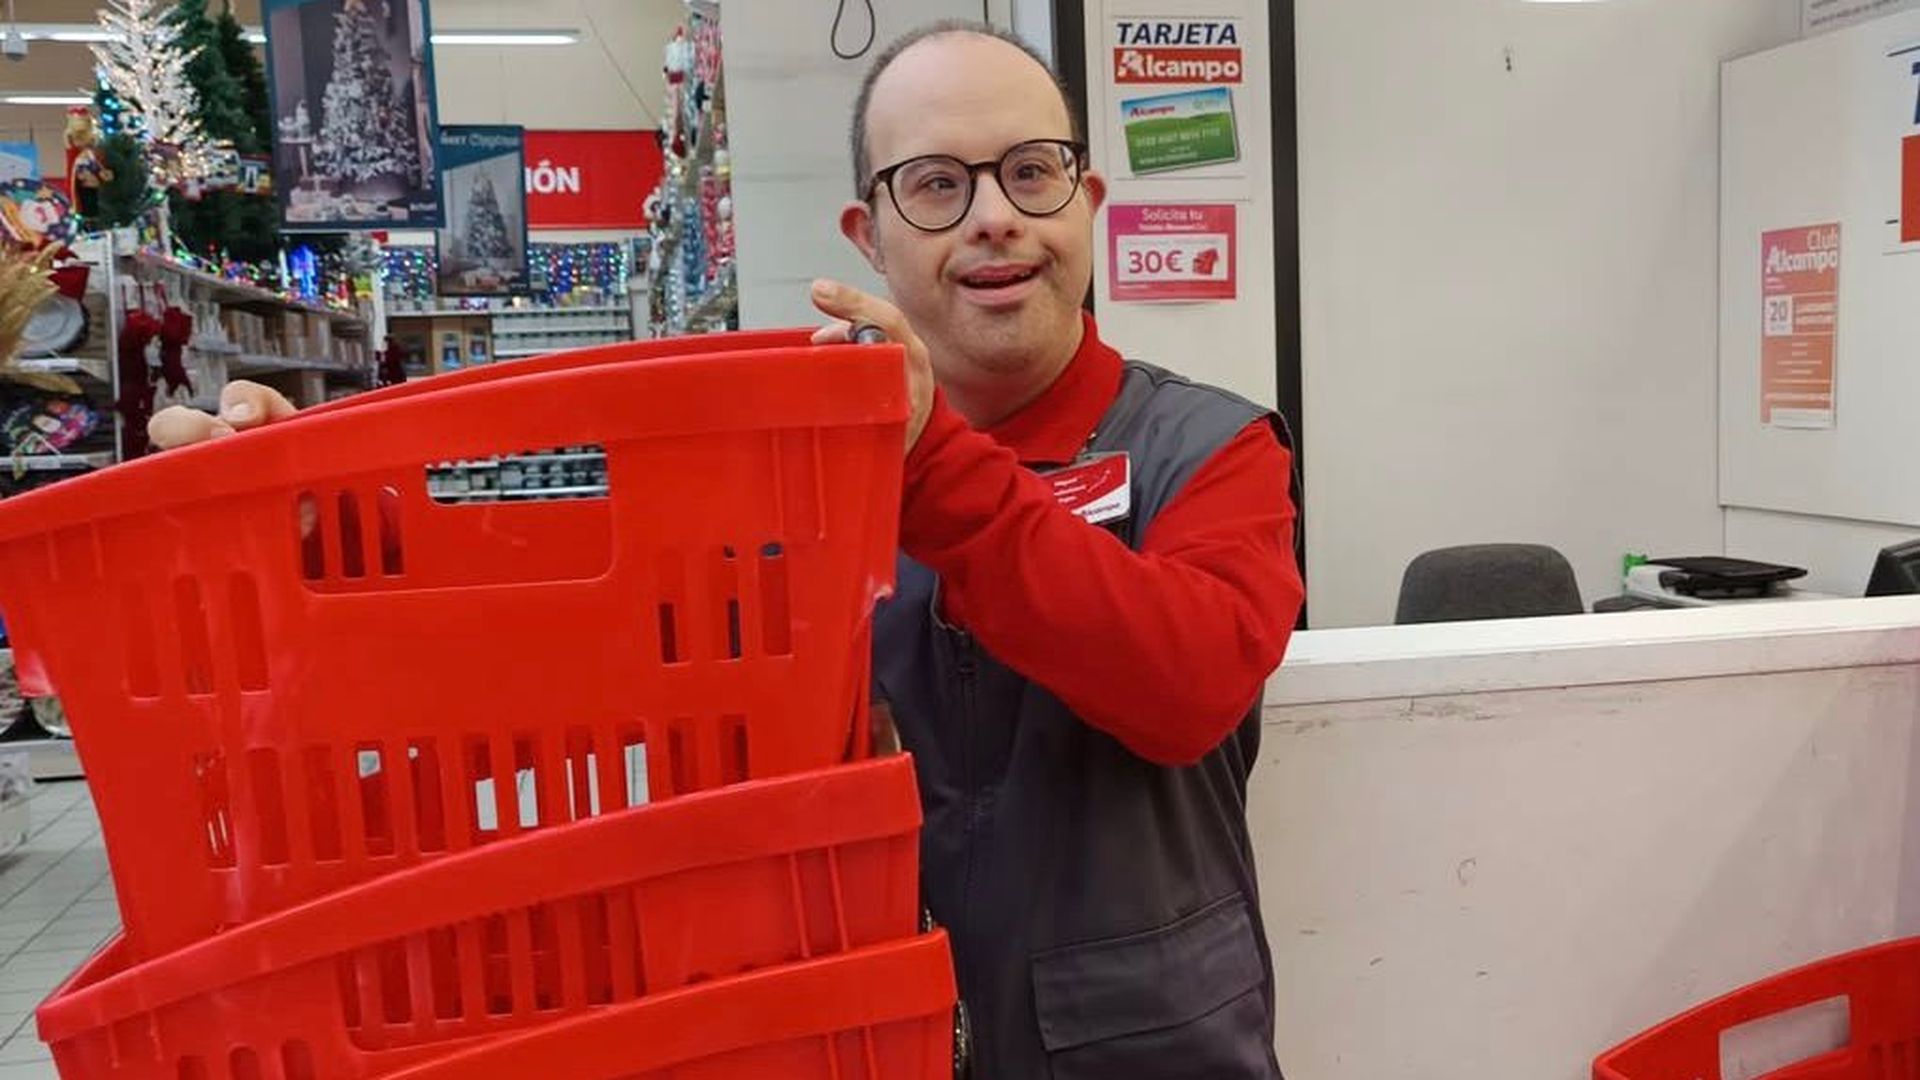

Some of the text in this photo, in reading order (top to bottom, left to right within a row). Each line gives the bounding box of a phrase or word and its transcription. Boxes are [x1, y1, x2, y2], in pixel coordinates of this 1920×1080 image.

[1117, 23, 1237, 44] TARJETA
[1118, 50, 1240, 80] Alcampo
[1142, 208, 1188, 221] Solicita
[1128, 250, 1183, 274] 30€
[1765, 246, 1838, 273] Alcampo
[1769, 301, 1787, 322] 20
